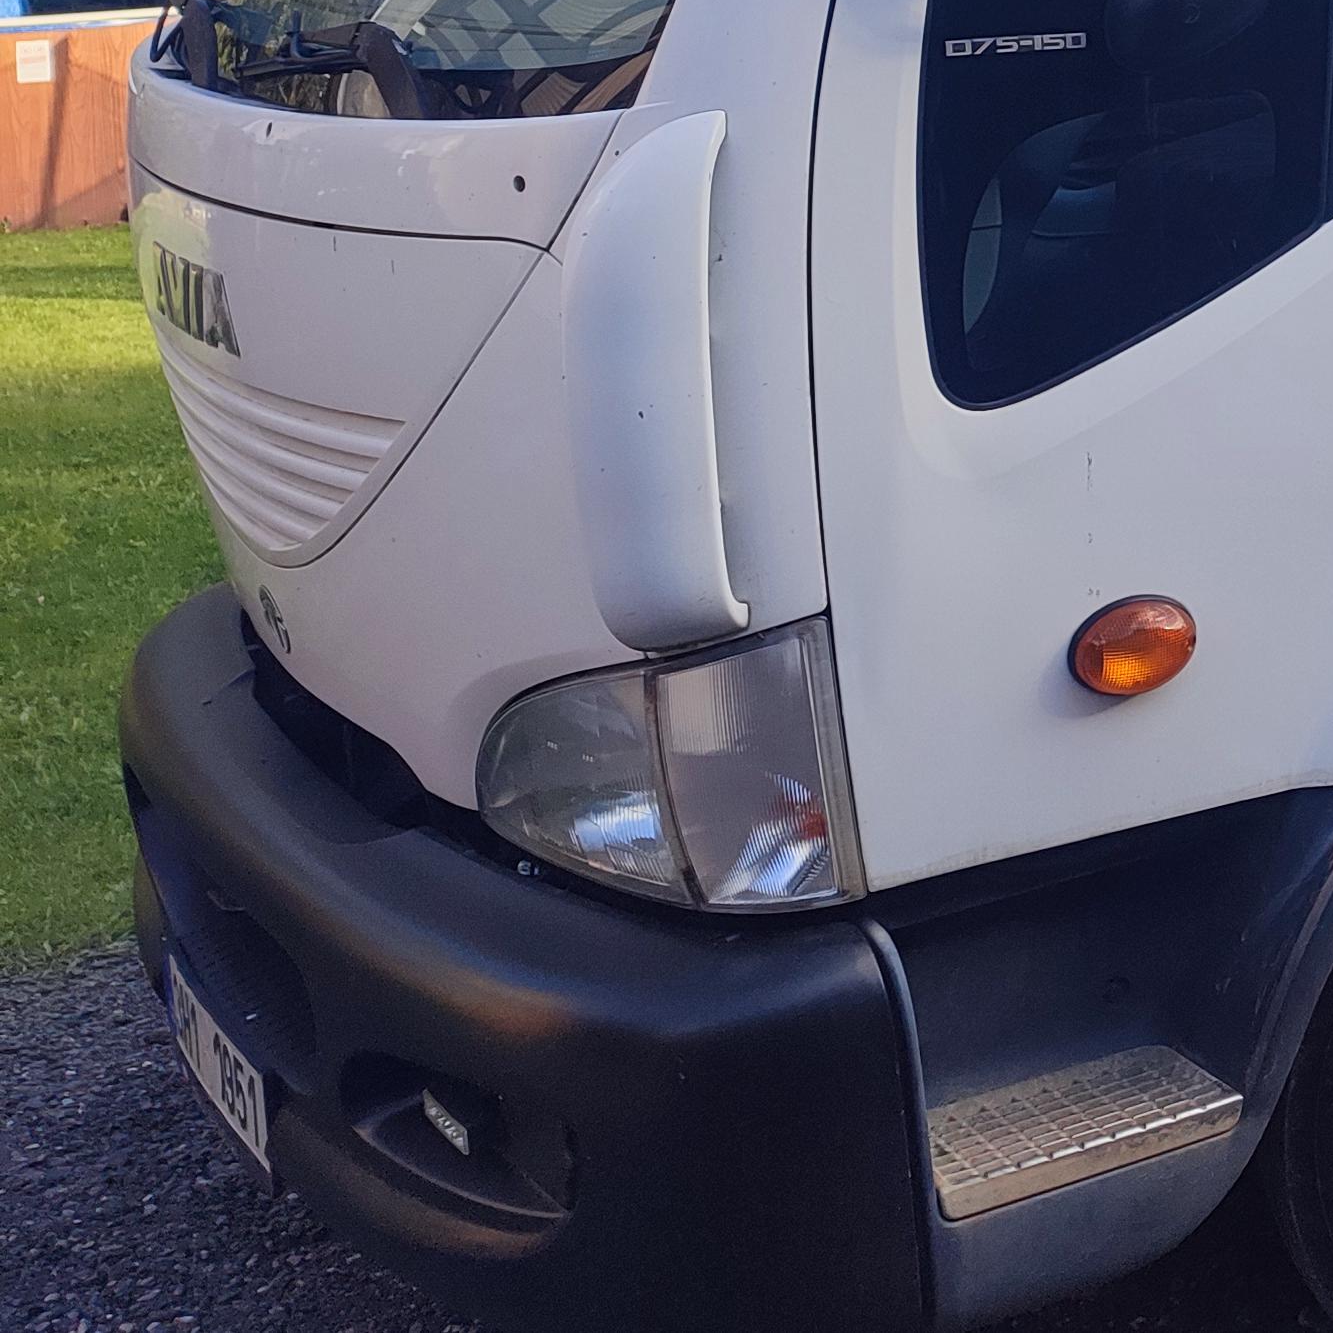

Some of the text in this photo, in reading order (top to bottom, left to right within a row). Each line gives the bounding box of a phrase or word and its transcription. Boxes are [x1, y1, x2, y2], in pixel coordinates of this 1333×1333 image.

[945, 32, 1087, 57] D75-150
[153, 240, 241, 358] AVIA
[213, 1031, 260, 1148] 1951
